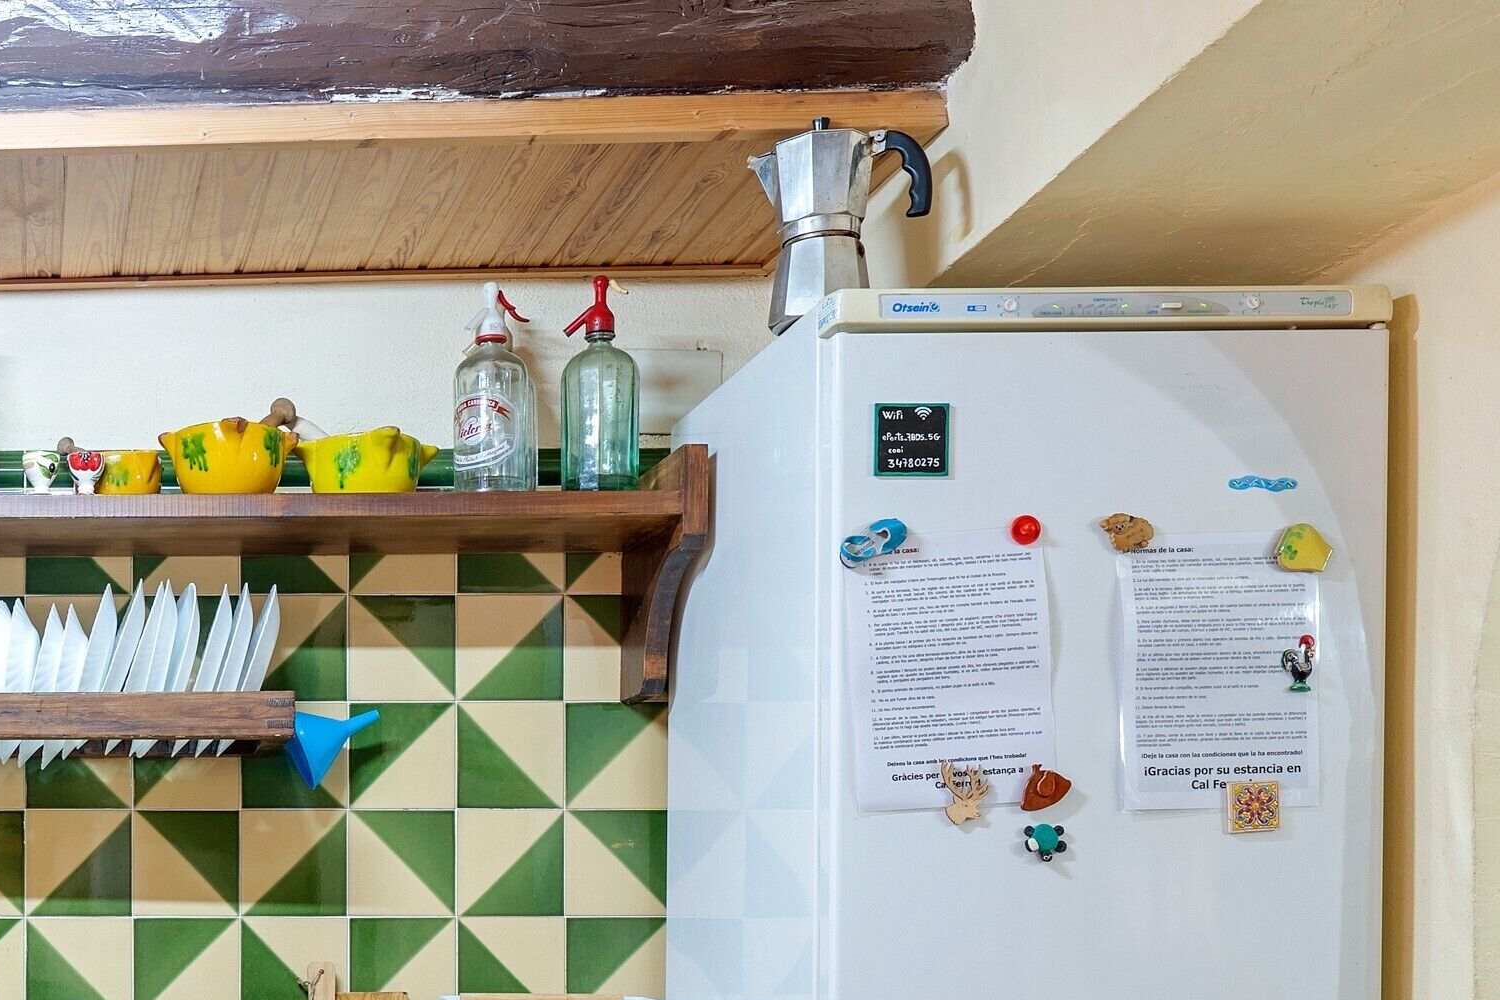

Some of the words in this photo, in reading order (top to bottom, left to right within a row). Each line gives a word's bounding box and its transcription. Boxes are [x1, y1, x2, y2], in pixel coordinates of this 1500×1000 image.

[892, 302, 930, 312] Otsein
[888, 457, 940, 468] 34780275
[892, 773, 924, 781] Gràcies
[983, 767, 1016, 775] estança
[1195, 767, 1213, 777] por
[1234, 764, 1283, 774] estancia
[1192, 780, 1209, 789] Cal
